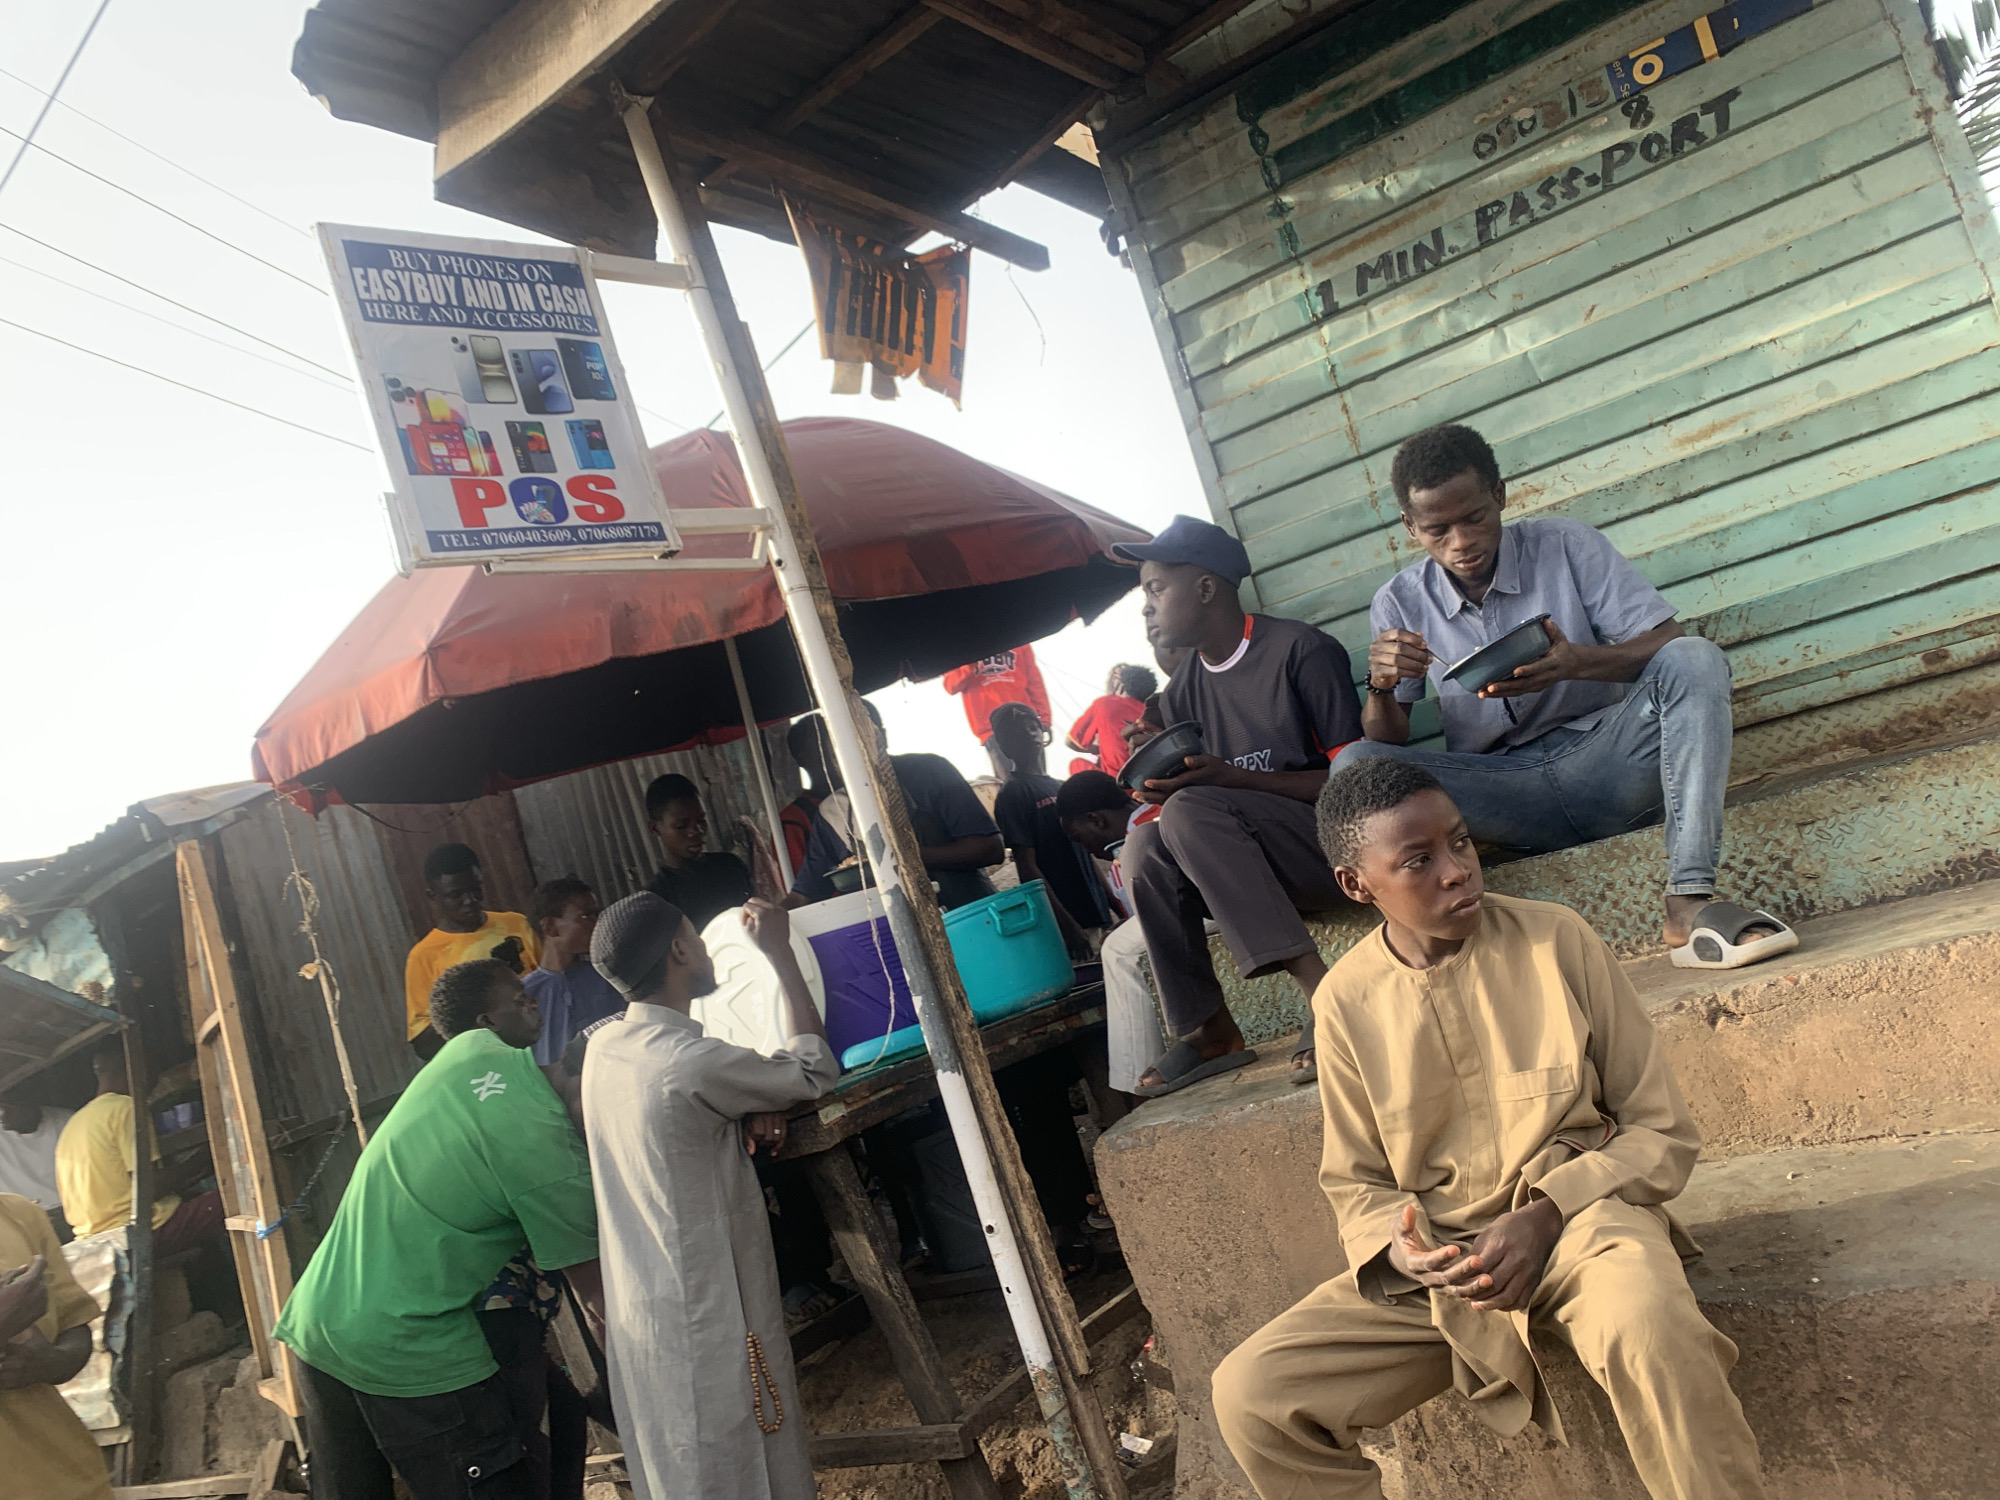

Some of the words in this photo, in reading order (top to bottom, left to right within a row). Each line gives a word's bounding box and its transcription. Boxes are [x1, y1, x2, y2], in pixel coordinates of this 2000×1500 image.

[387, 249, 432, 272] BUY
[437, 254, 520, 281] PHONES
[522, 263, 554, 282] ON
[1315, 279, 1339, 318] 1
[1356, 226, 1460, 297] MIN.
[351, 266, 458, 306] EASYBUY
[460, 276, 507, 311] AND
[506, 281, 536, 312] IN
[534, 282, 593, 317] CASH
[364, 302, 424, 321] HERE
[427, 306, 467, 324] AND
[472, 310, 599, 333] ACCESSORIES.
[450, 474, 626, 528] POS
[438, 532, 480, 548] TEL:
